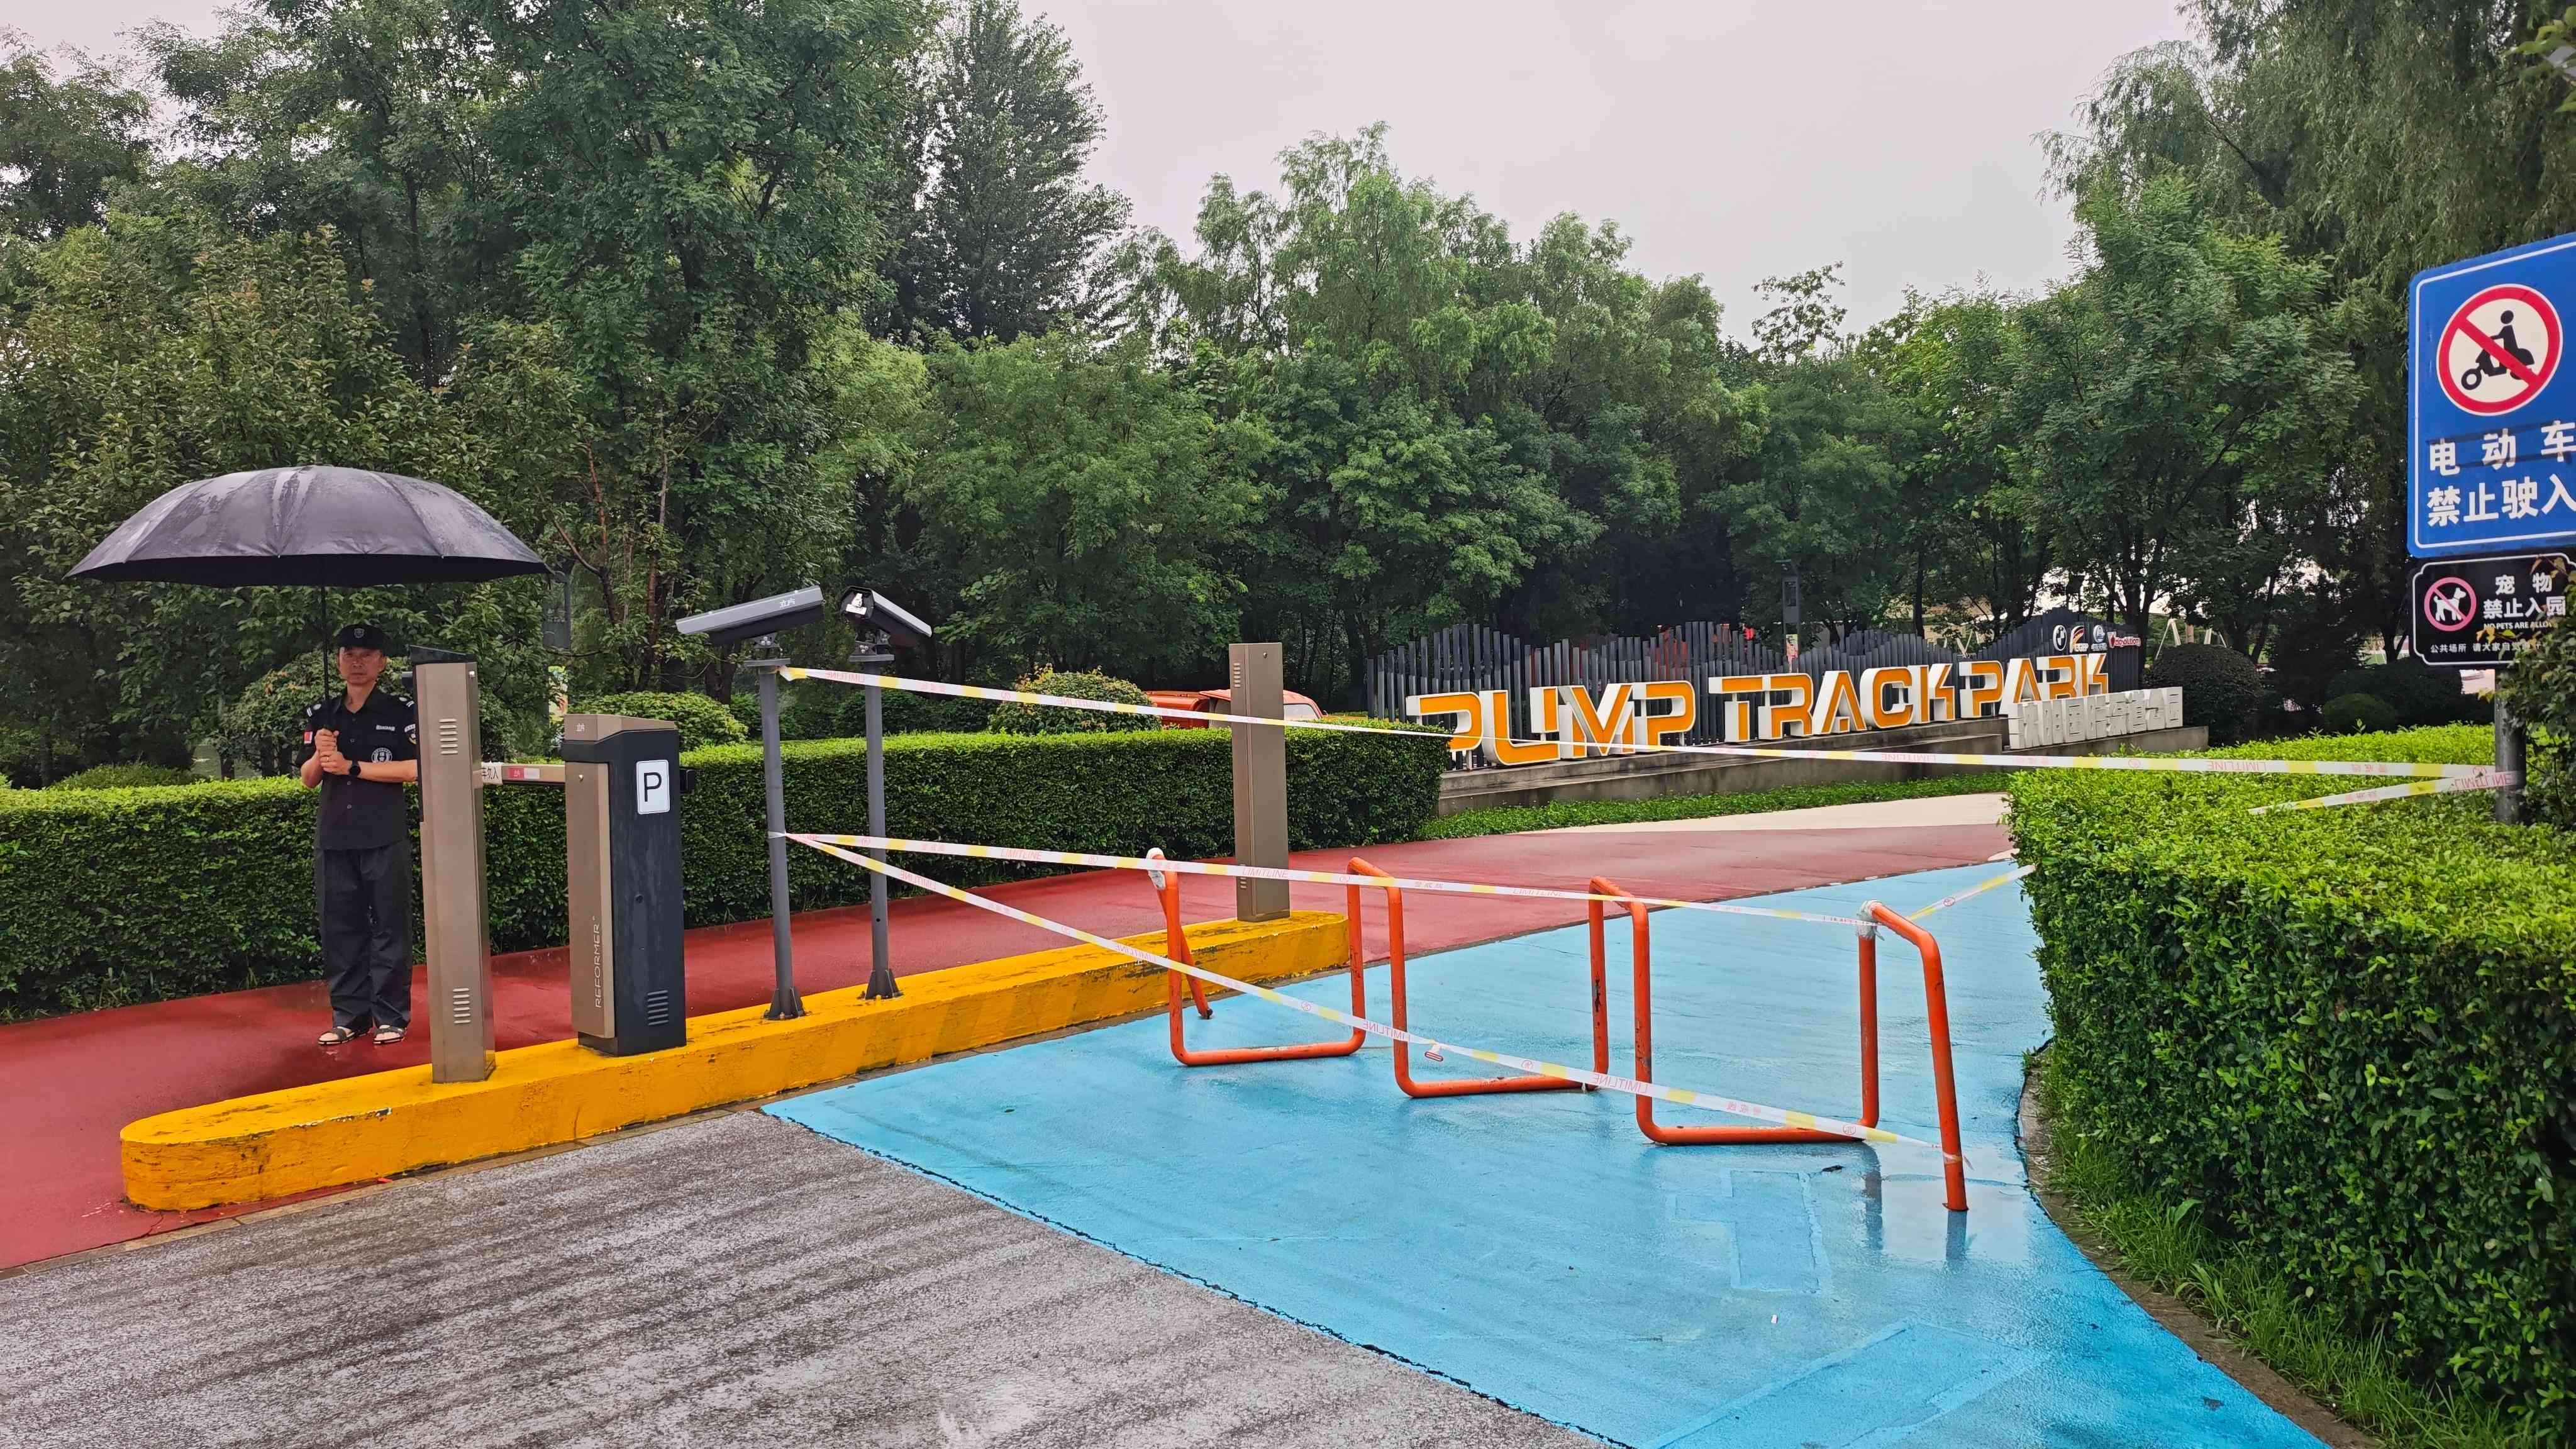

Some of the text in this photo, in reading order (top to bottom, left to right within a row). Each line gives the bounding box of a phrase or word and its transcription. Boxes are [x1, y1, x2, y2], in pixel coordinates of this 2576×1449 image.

[2429, 419, 2576, 477] 电动车
[2427, 474, 2576, 527] 禁止驶入
[2495, 572, 2553, 595] 宠物
[2483, 596, 2566, 619] 禁止入园
[1406, 653, 2109, 766] PUMP TRACK PARK
[2206, 760, 2268, 772] LIMITLINE
[643, 772, 662, 802] P
[1242, 866, 1289, 878] LIMITLINE
[593, 923, 602, 1008] REFORMER
